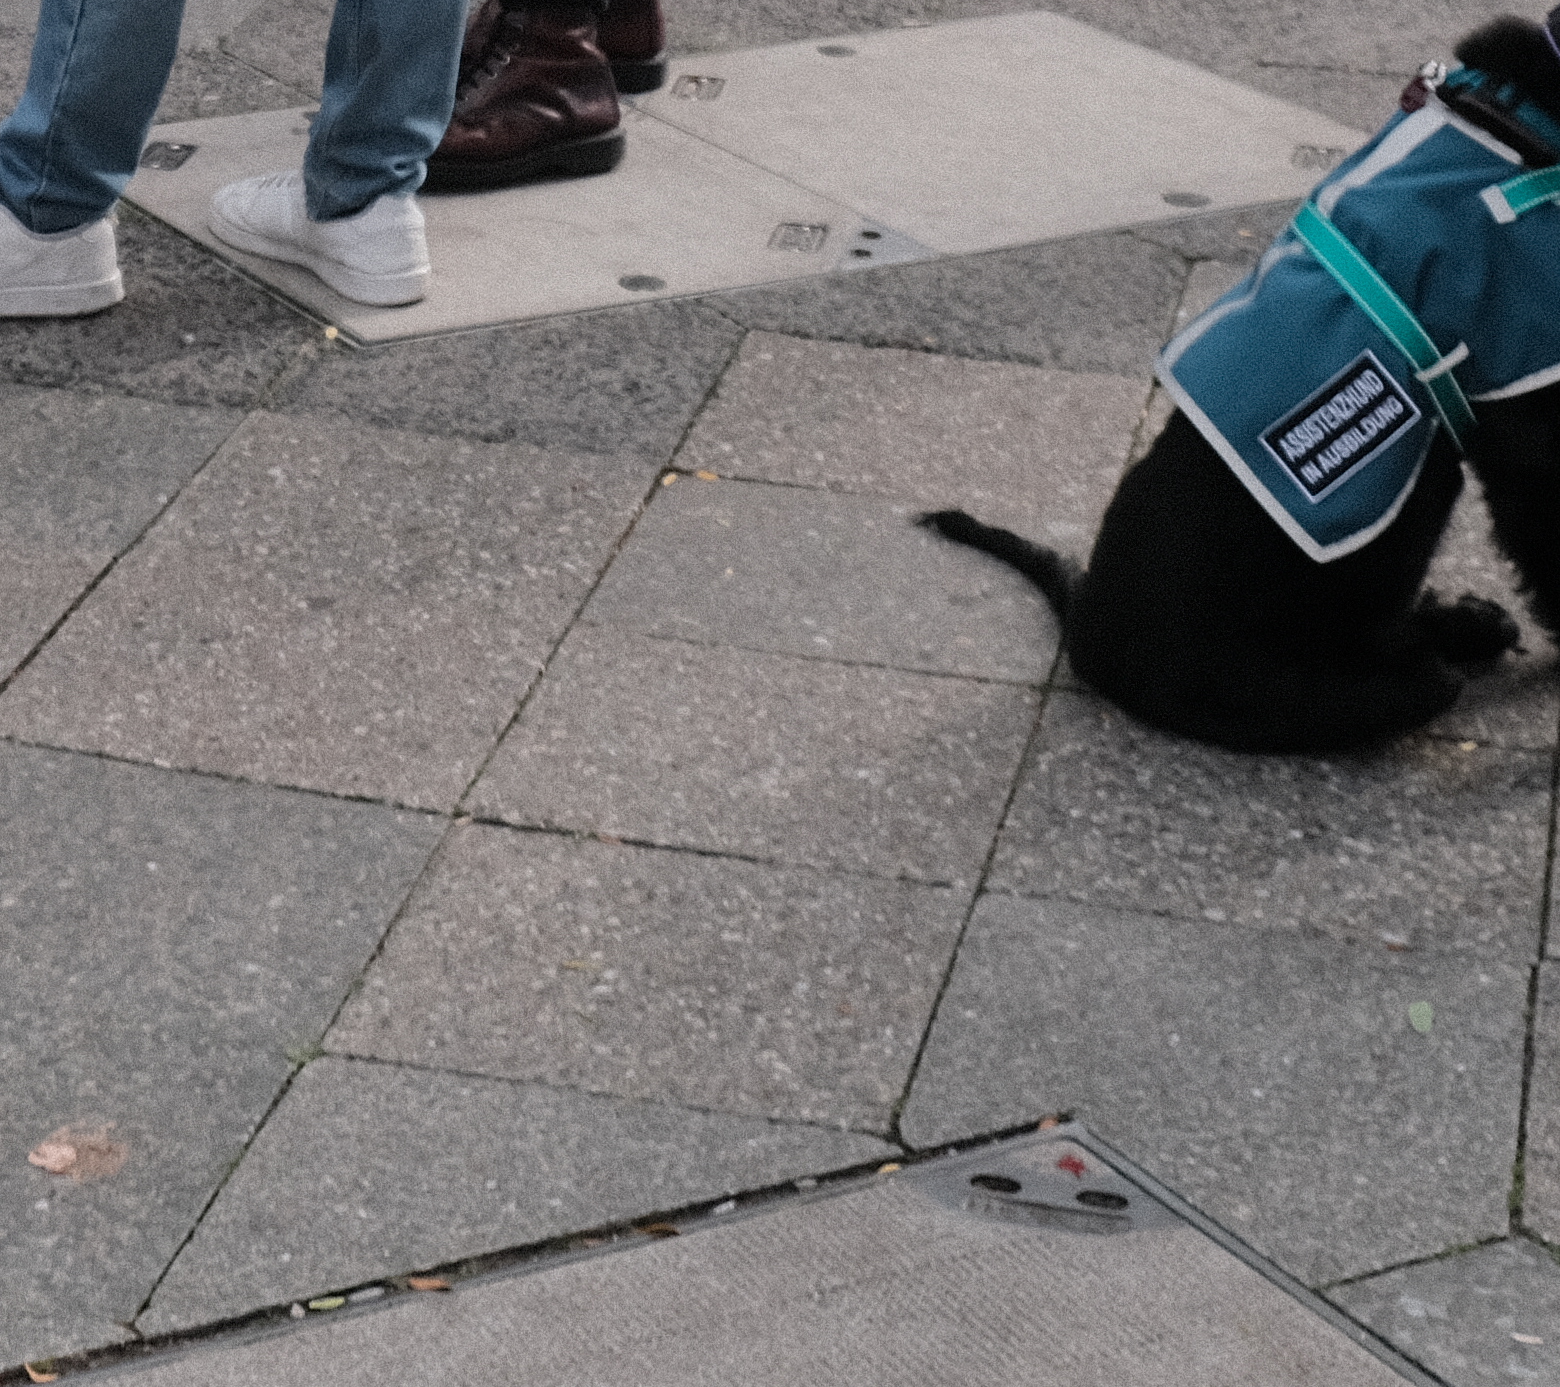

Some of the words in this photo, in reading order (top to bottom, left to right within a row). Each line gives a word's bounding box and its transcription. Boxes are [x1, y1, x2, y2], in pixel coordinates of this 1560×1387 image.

[1279, 368, 1385, 463] ASSISTENZHUND
[1299, 460, 1325, 485] IN
[1316, 394, 1405, 474] AUSBILDUNG
